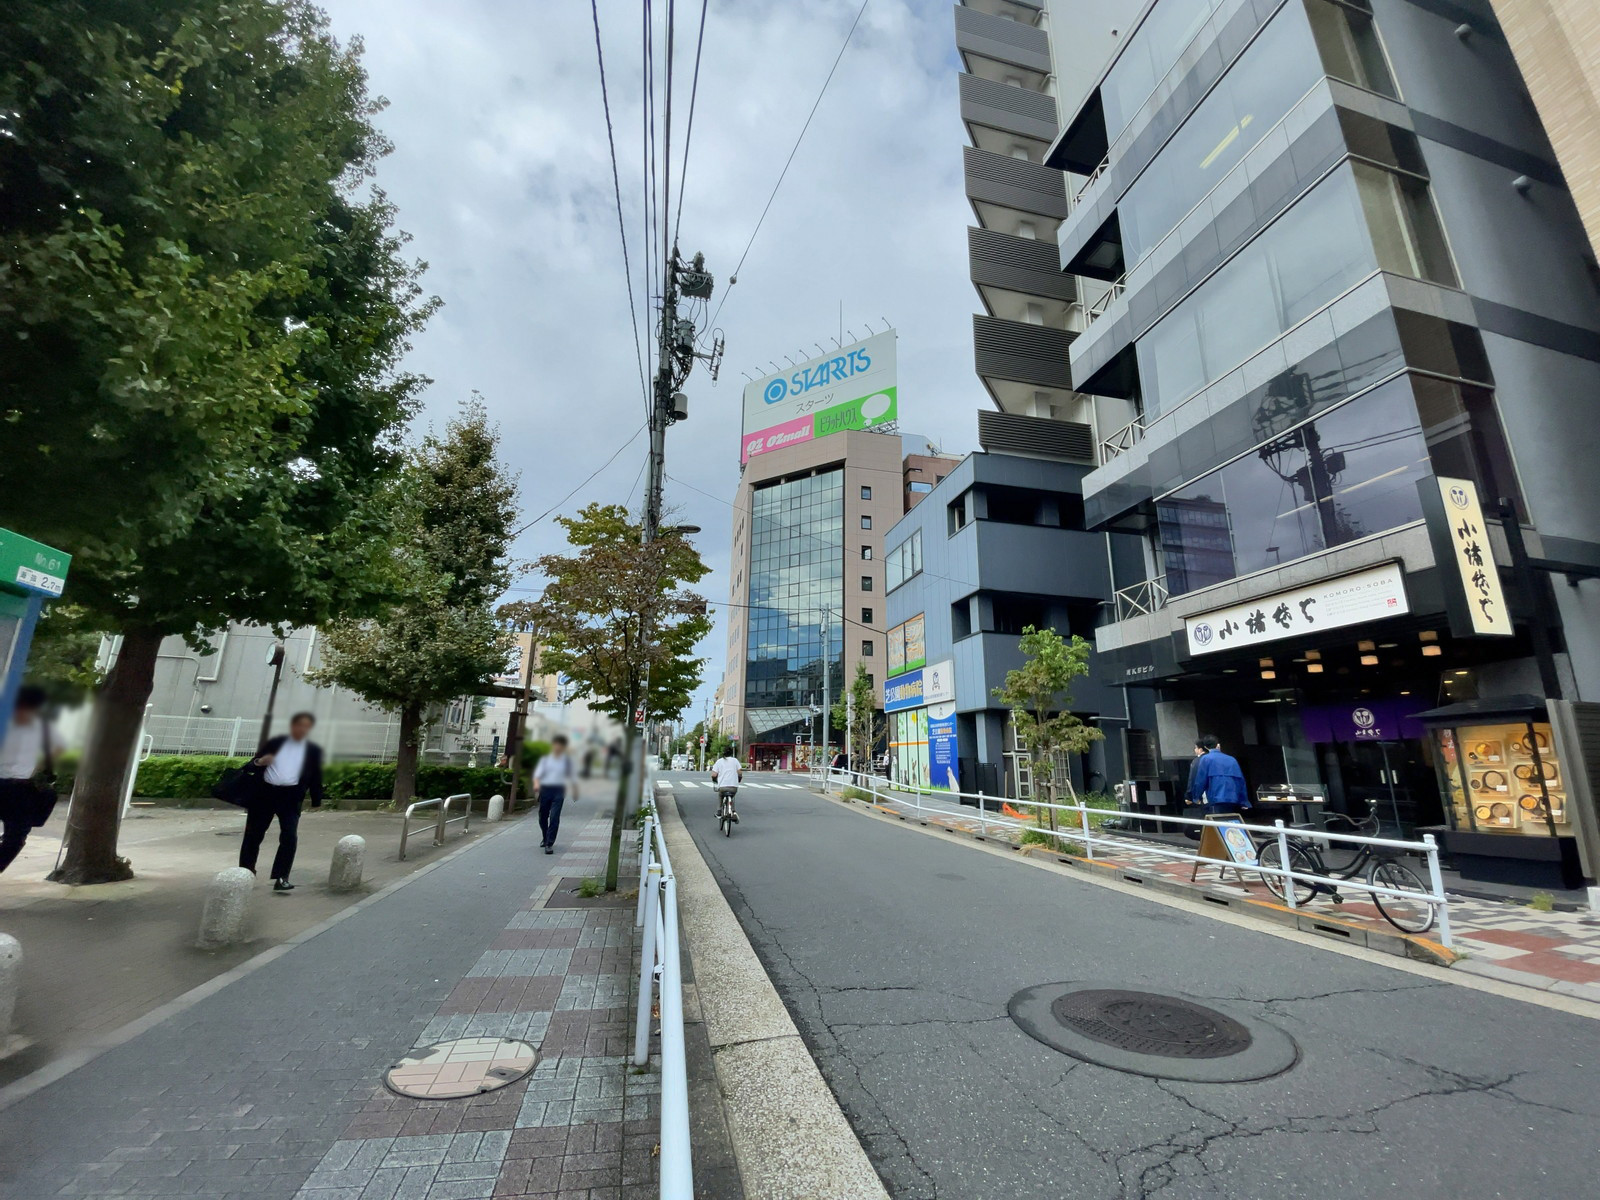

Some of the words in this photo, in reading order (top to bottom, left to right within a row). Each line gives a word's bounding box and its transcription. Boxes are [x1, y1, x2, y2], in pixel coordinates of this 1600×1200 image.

[790, 347, 872, 396] STARTS
[795, 392, 835, 414] スターツ
[766, 424, 811, 448] OZmall
[1322, 578, 1394, 599] KOMORO-SOBA
